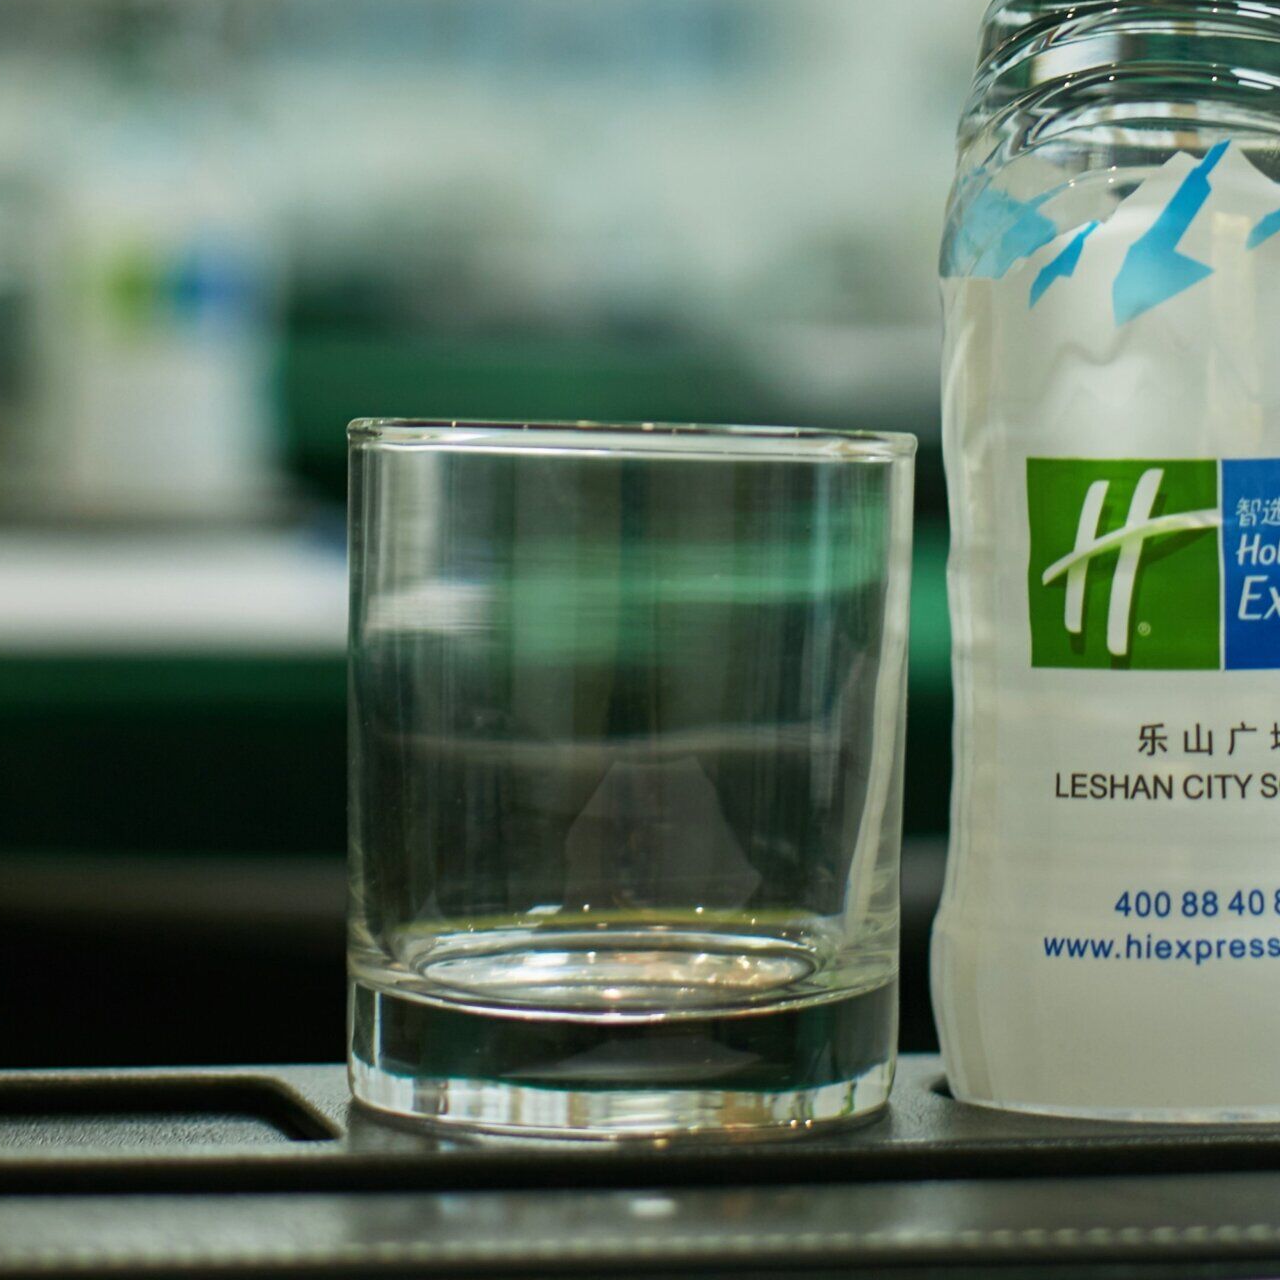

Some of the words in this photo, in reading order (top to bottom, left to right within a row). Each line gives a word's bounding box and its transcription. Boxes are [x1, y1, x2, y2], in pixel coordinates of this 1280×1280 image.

[1055, 772, 1174, 799] LESHAN
[1182, 774, 1252, 800] CITY
[1114, 891, 1171, 919] 400
[1180, 890, 1220, 917] 88
[1227, 888, 1266, 916] 40
